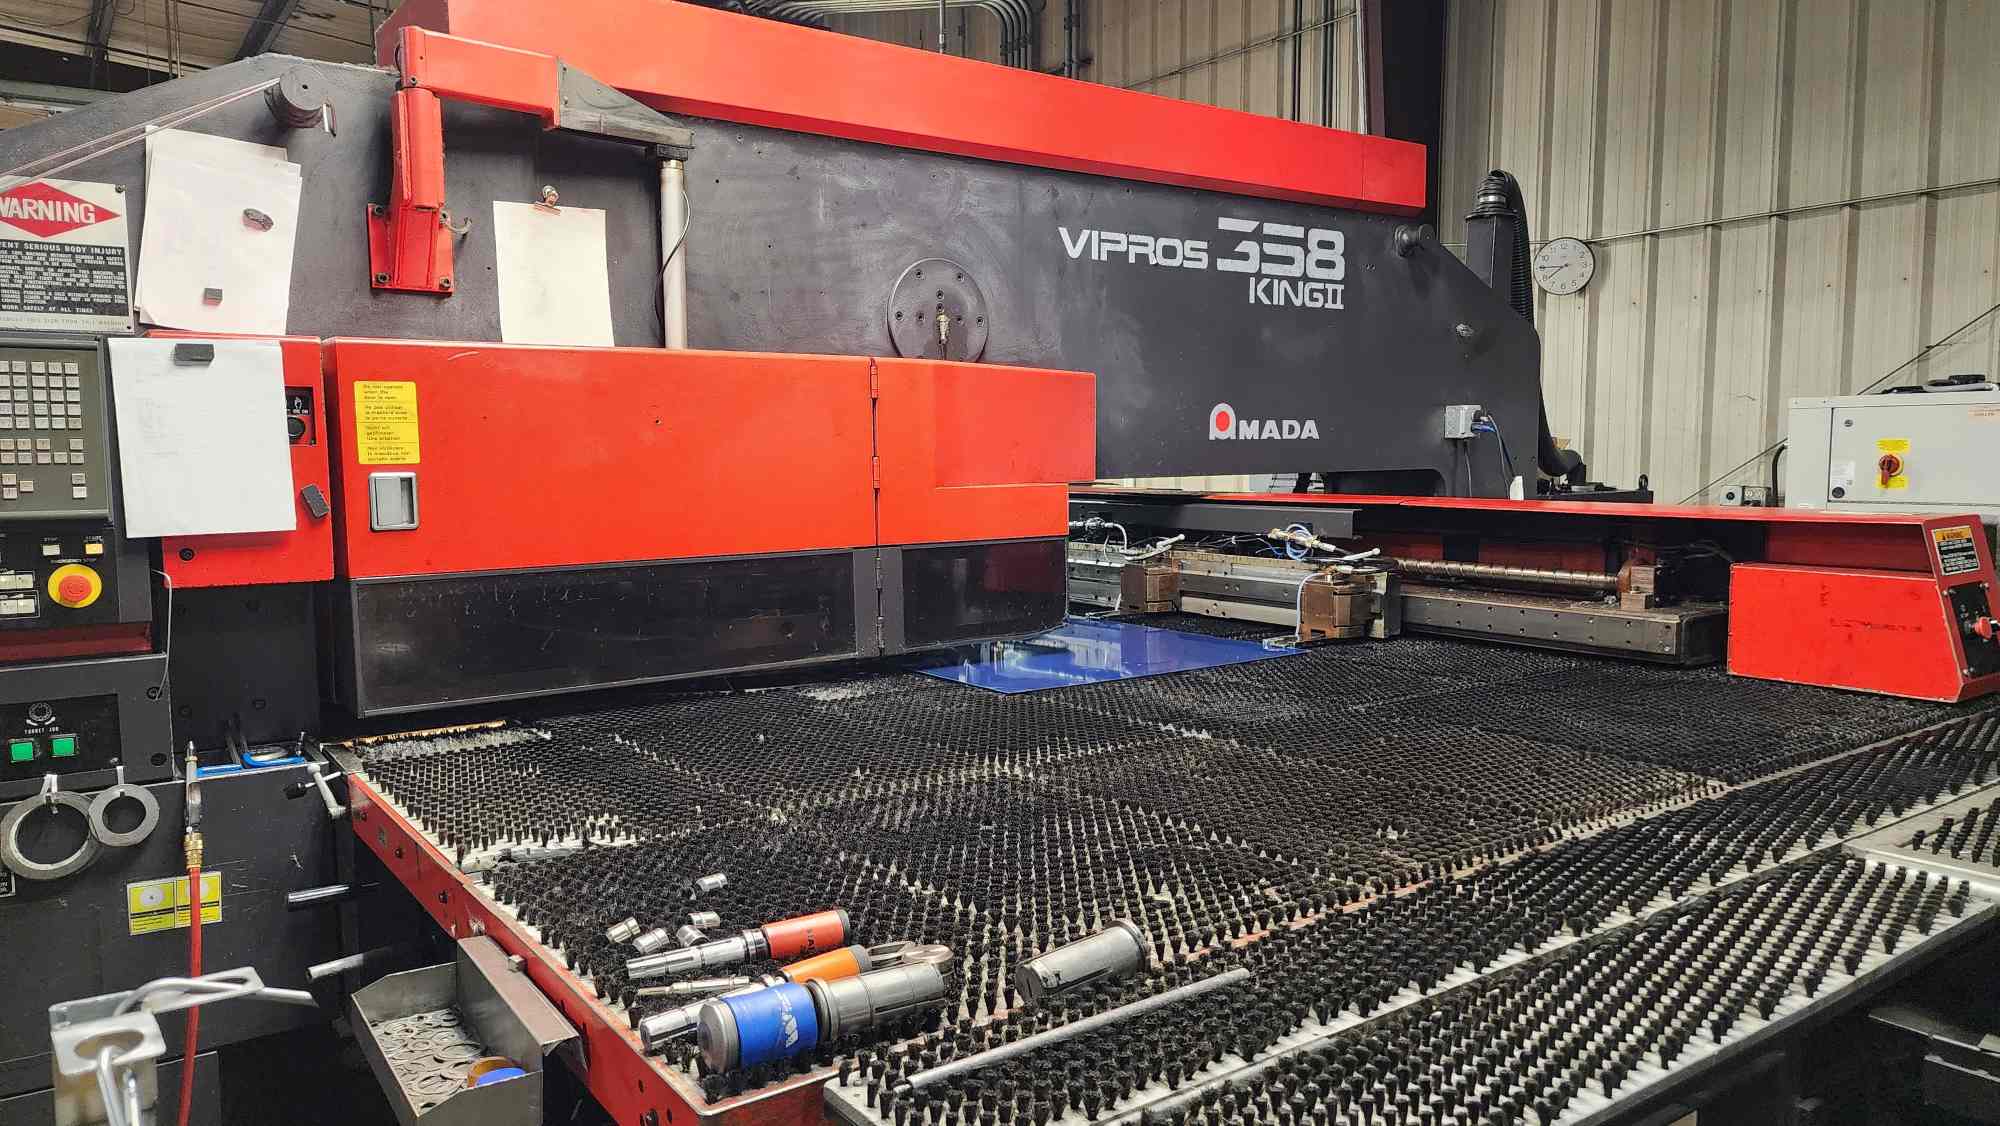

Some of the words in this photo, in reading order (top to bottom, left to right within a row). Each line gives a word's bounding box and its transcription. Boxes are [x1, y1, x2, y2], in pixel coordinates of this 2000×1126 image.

[24, 242, 61, 251] SERIOUS
[64, 245, 87, 254] BODY
[91, 247, 122, 255] INJURY
[1058, 226, 1209, 269] VIPROS
[1216, 217, 1346, 281] 358
[1208, 402, 1320, 441] AMADA
